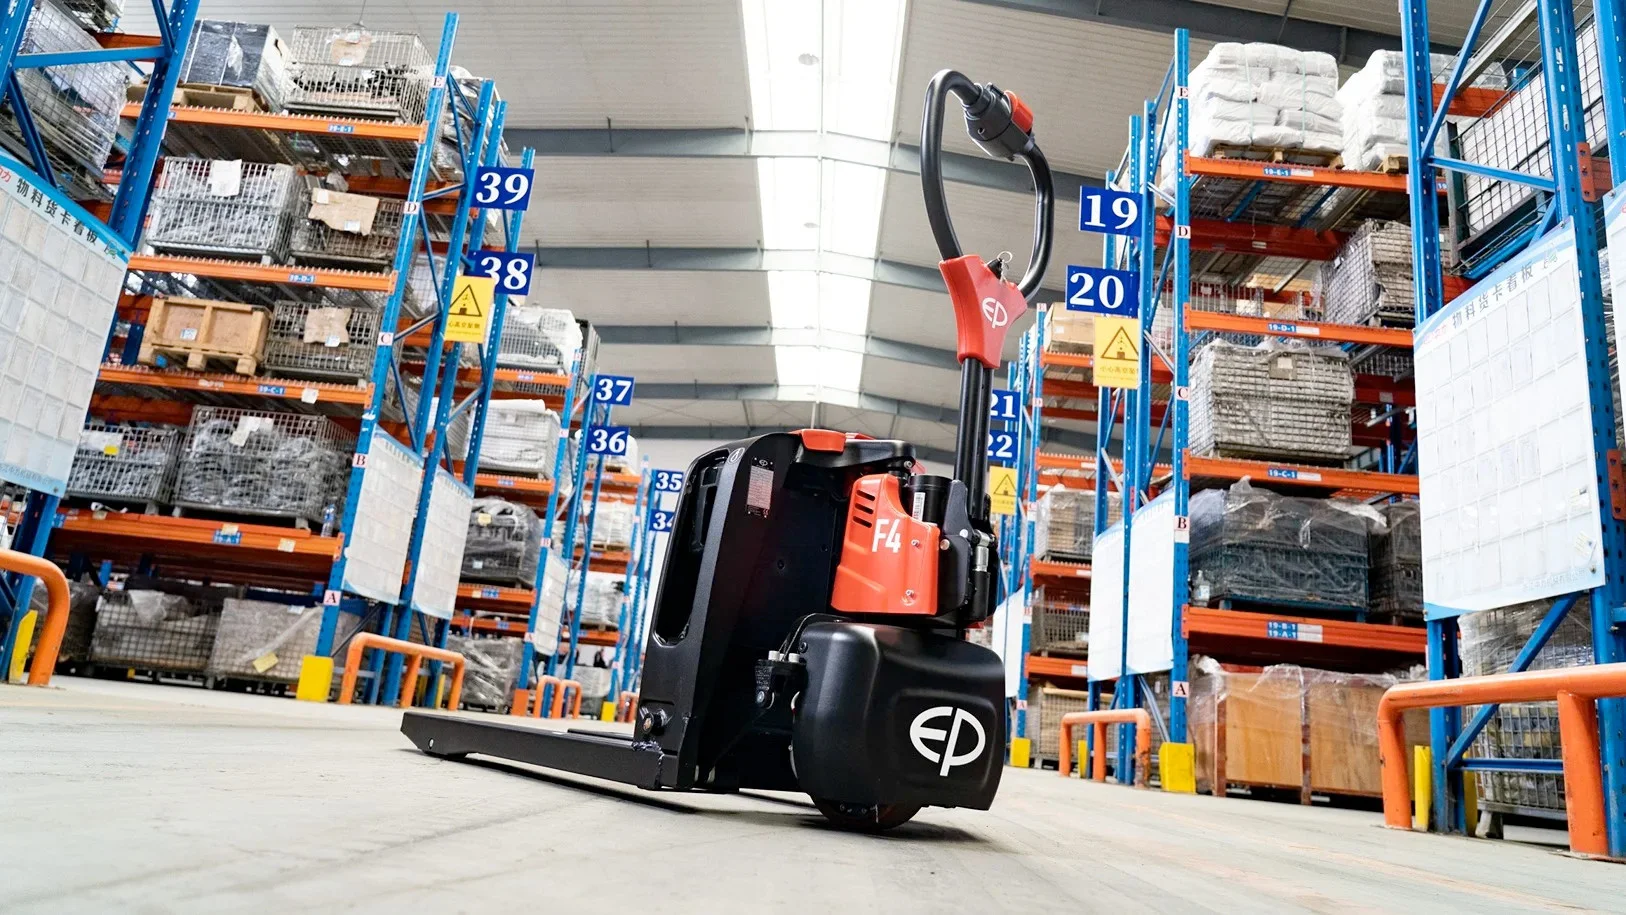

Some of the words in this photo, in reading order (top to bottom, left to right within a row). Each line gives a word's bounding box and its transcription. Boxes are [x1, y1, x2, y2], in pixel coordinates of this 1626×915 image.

[1180, 87, 1189, 97] E
[476, 172, 529, 205] 39
[16, 178, 98, 246] 物料货卡看板
[406, 203, 417, 213] D
[1084, 194, 1138, 230] 19
[1177, 226, 1188, 237] D
[481, 256, 529, 290] 38
[1069, 272, 1124, 309] 20
[1452, 260, 1534, 330] 物料货卡看板
[982, 297, 1008, 329] EP
[380, 333, 391, 344] C
[596, 378, 632, 402] 37
[1178, 387, 1188, 398] C
[590, 428, 626, 453] 36
[356, 455, 366, 466] B
[655, 472, 683, 491] 35
[653, 511, 674, 530] 3
[1177, 517, 1187, 529] B
[871, 518, 901, 553] F4
[326, 592, 337, 604] A
[1175, 684, 1187, 696] A
[909, 706, 987, 777] EP
